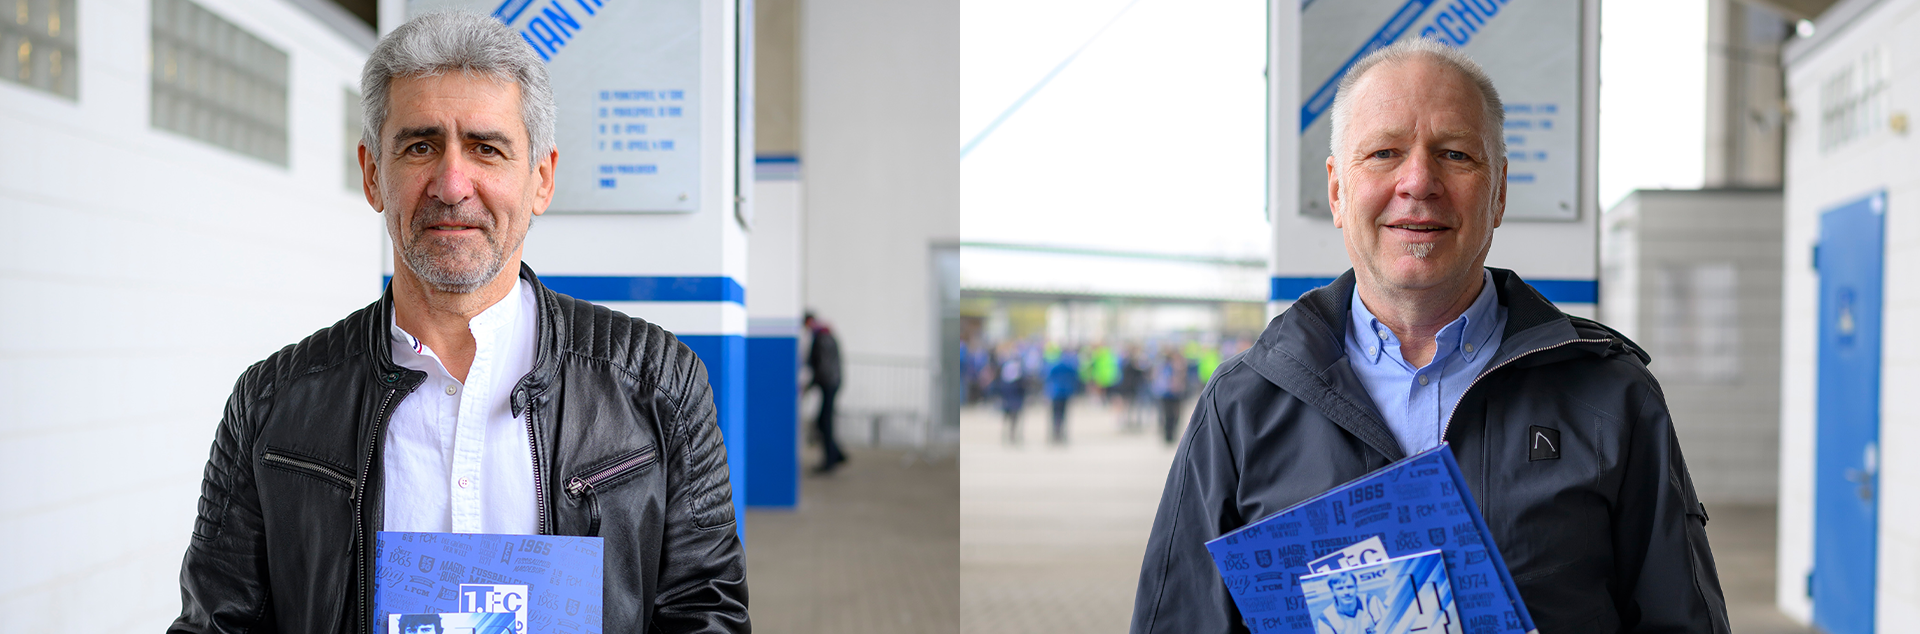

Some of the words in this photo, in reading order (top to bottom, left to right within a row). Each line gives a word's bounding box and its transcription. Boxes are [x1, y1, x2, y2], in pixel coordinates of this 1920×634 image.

[1348, 483, 1384, 506] 1965
[518, 539, 553, 556] 1965
[1395, 536, 1422, 551] 1965
[388, 551, 412, 567] 1965
[1224, 558, 1249, 571] 1965
[1457, 573, 1489, 590] 1974
[537, 595, 559, 611] 1965
[1284, 595, 1306, 611] 197
